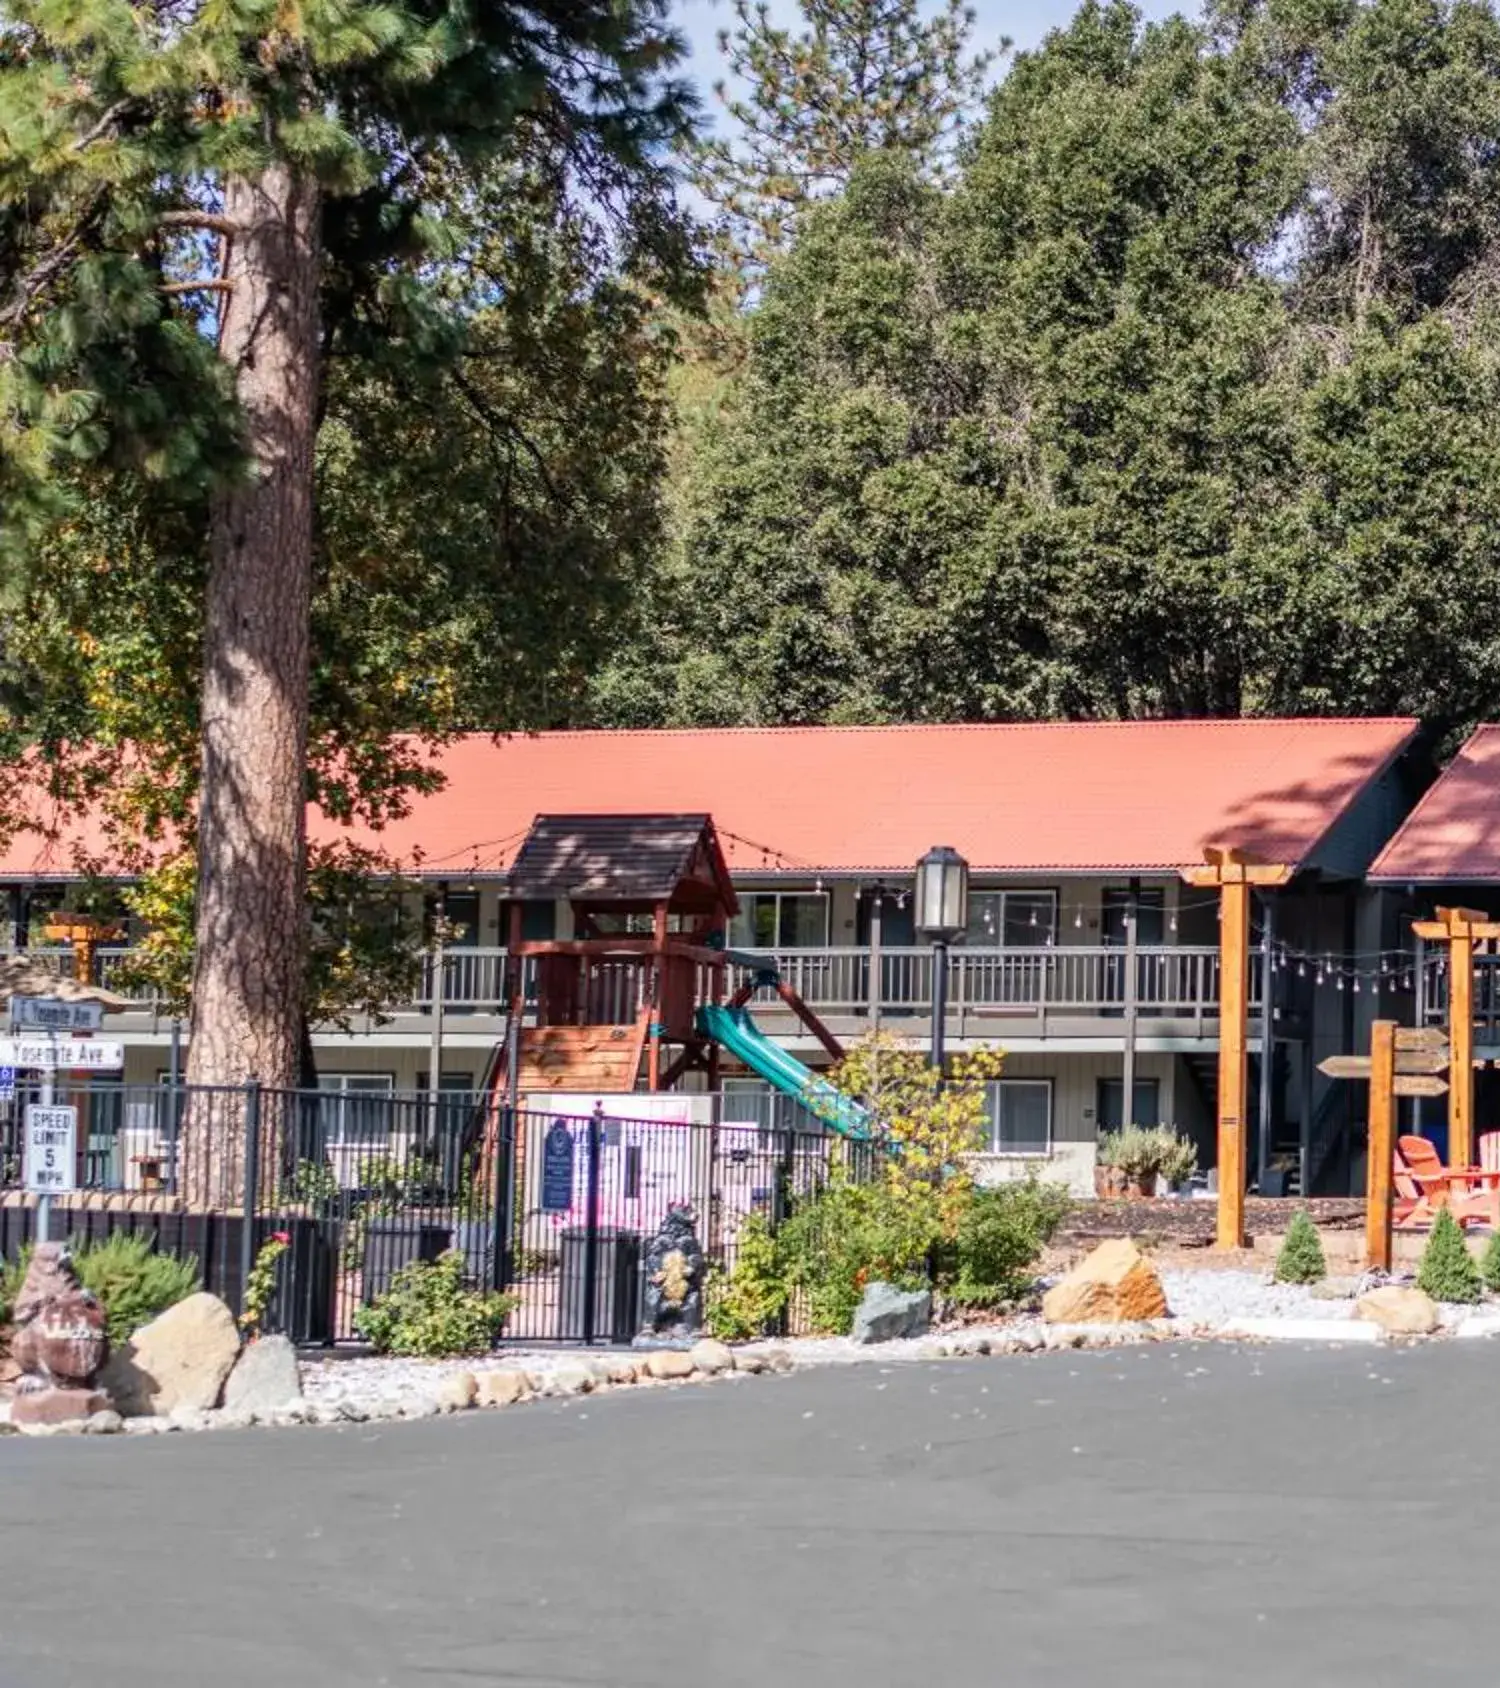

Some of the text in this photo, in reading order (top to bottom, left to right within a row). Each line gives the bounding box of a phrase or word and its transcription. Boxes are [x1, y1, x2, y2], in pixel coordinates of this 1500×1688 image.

[79, 1042, 104, 1063] Ave
[33, 1112, 71, 1129] SPEED
[33, 1130, 69, 1146] LIMIT
[45, 1147, 55, 1168] 5
[37, 1170, 64, 1185] MPH
